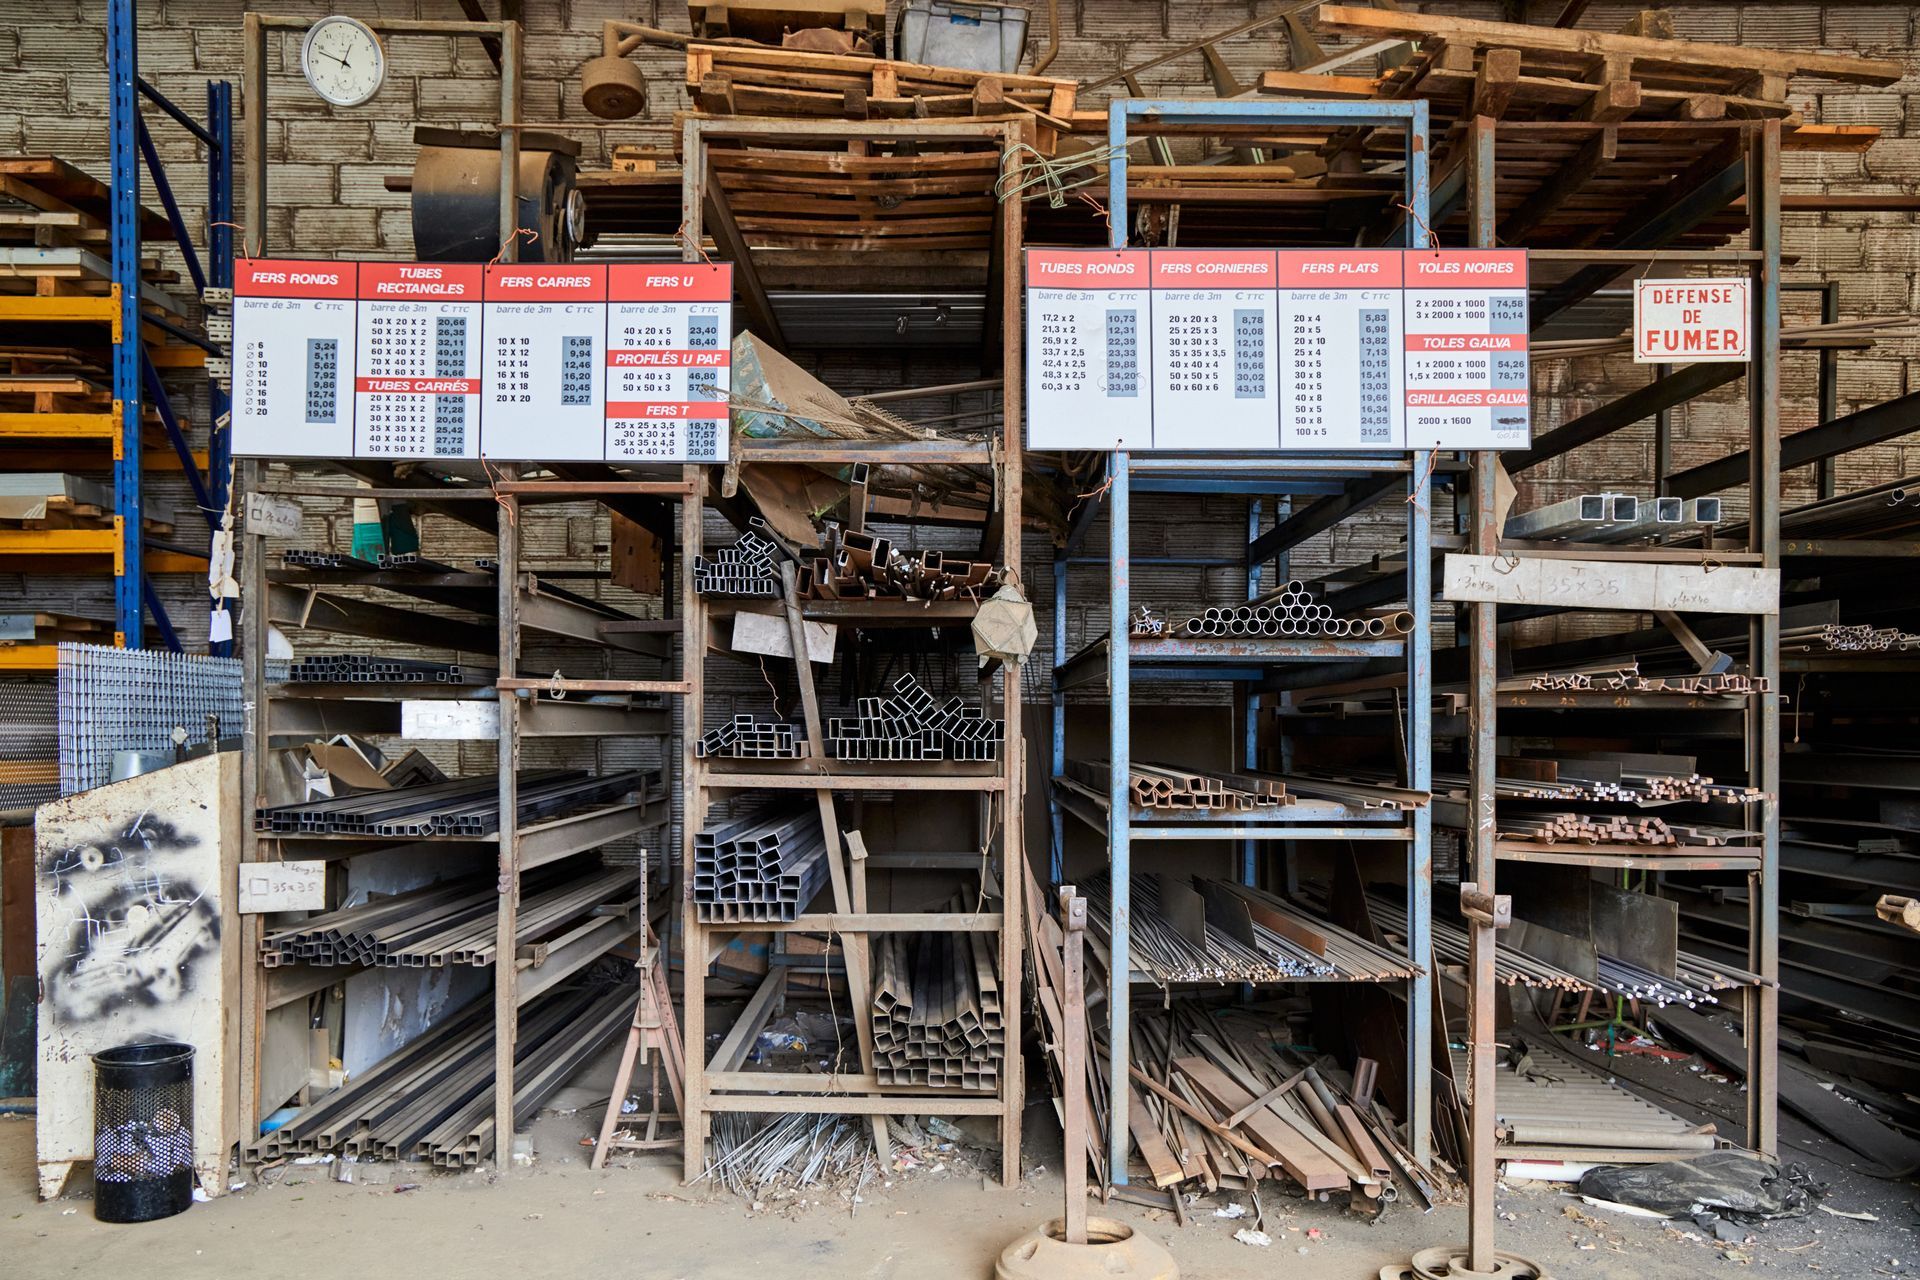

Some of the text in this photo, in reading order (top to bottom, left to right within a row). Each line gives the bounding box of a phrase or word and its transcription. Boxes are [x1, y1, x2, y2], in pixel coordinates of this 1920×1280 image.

[1040, 263, 1135, 274] TUBES RONDS
[1161, 264, 1268, 273] FERS CORNIERES
[1302, 263, 1379, 273] FERS PLATS
[1418, 262, 1514, 273] TOLES NOIRES
[400, 268, 442, 279] TUBES
[252, 272, 338, 285] FERS RONDS
[500, 277, 591, 287] FERS CARRES
[646, 276, 694, 287] FERS U
[377, 283, 464, 294] RECTANGLES
[1038, 291, 1094, 301] barre de 3m
[1165, 292, 1222, 300] barre de 3m
[1291, 292, 1348, 300] barre de 3m
[1653, 288, 1732, 304] DÉFENSE
[244, 300, 301, 309] barre de 3m
[371, 304, 427, 312] barre de 3m
[1497, 300, 1523, 308] 74,58
[496, 305, 552, 314] barre de 3m
[620, 305, 676, 314] barre de 3m
[1109, 315, 1135, 323] 10,73
[1366, 314, 1386, 322] 5,83
[1492, 312, 1523, 320] 110,14
[1683, 310, 1702, 324] DE
[1242, 317, 1263, 325] 8,78
[690, 327, 716, 335] 23,40
[1109, 327, 1134, 335] 12,31
[1237, 328, 1263, 336] 10,08
[1366, 326, 1386, 334] 6,98
[570, 339, 591, 347] 6,98
[1108, 338, 1135, 346] 22,39
[1361, 337, 1386, 345] 13,82
[1424, 338, 1511, 348] TOLES GALVA
[1647, 329, 1738, 351] FUMER
[570, 350, 591, 358] 9,94
[1109, 349, 1136, 357] 23,33
[1237, 351, 1264, 359] 16,49
[616, 351, 722, 364] PROFILÉS U PAF
[314, 362, 335, 370] 5,62
[565, 361, 590, 369] 12,46
[1108, 361, 1136, 369] 29,88
[1238, 362, 1264, 370] 19,66
[1361, 360, 1387, 368] 10,15
[1498, 361, 1524, 369] 54,26
[314, 372, 335, 380] 7,92
[1109, 372, 1136, 380] 34,20
[1498, 372, 1524, 380] 78,79
[314, 381, 335, 389] 9,86
[368, 380, 469, 392] TUBES CARRÉS
[564, 384, 590, 392] 20,45
[1109, 384, 1136, 392] 33,98
[1237, 385, 1264, 393] 43,13
[1361, 383, 1387, 391] 13,03
[308, 391, 335, 399] 12,74
[564, 395, 590, 403] 25,27
[1361, 394, 1387, 402] 19,66
[1408, 393, 1528, 404] GRILLAGES GALVA
[308, 400, 334, 408] 16,06
[308, 410, 334, 418] 19,94
[646, 406, 690, 415] FERS T
[1361, 417, 1388, 425] 24,55
[1361, 428, 1388, 436] 31,25
[689, 448, 715, 456] 28,80
